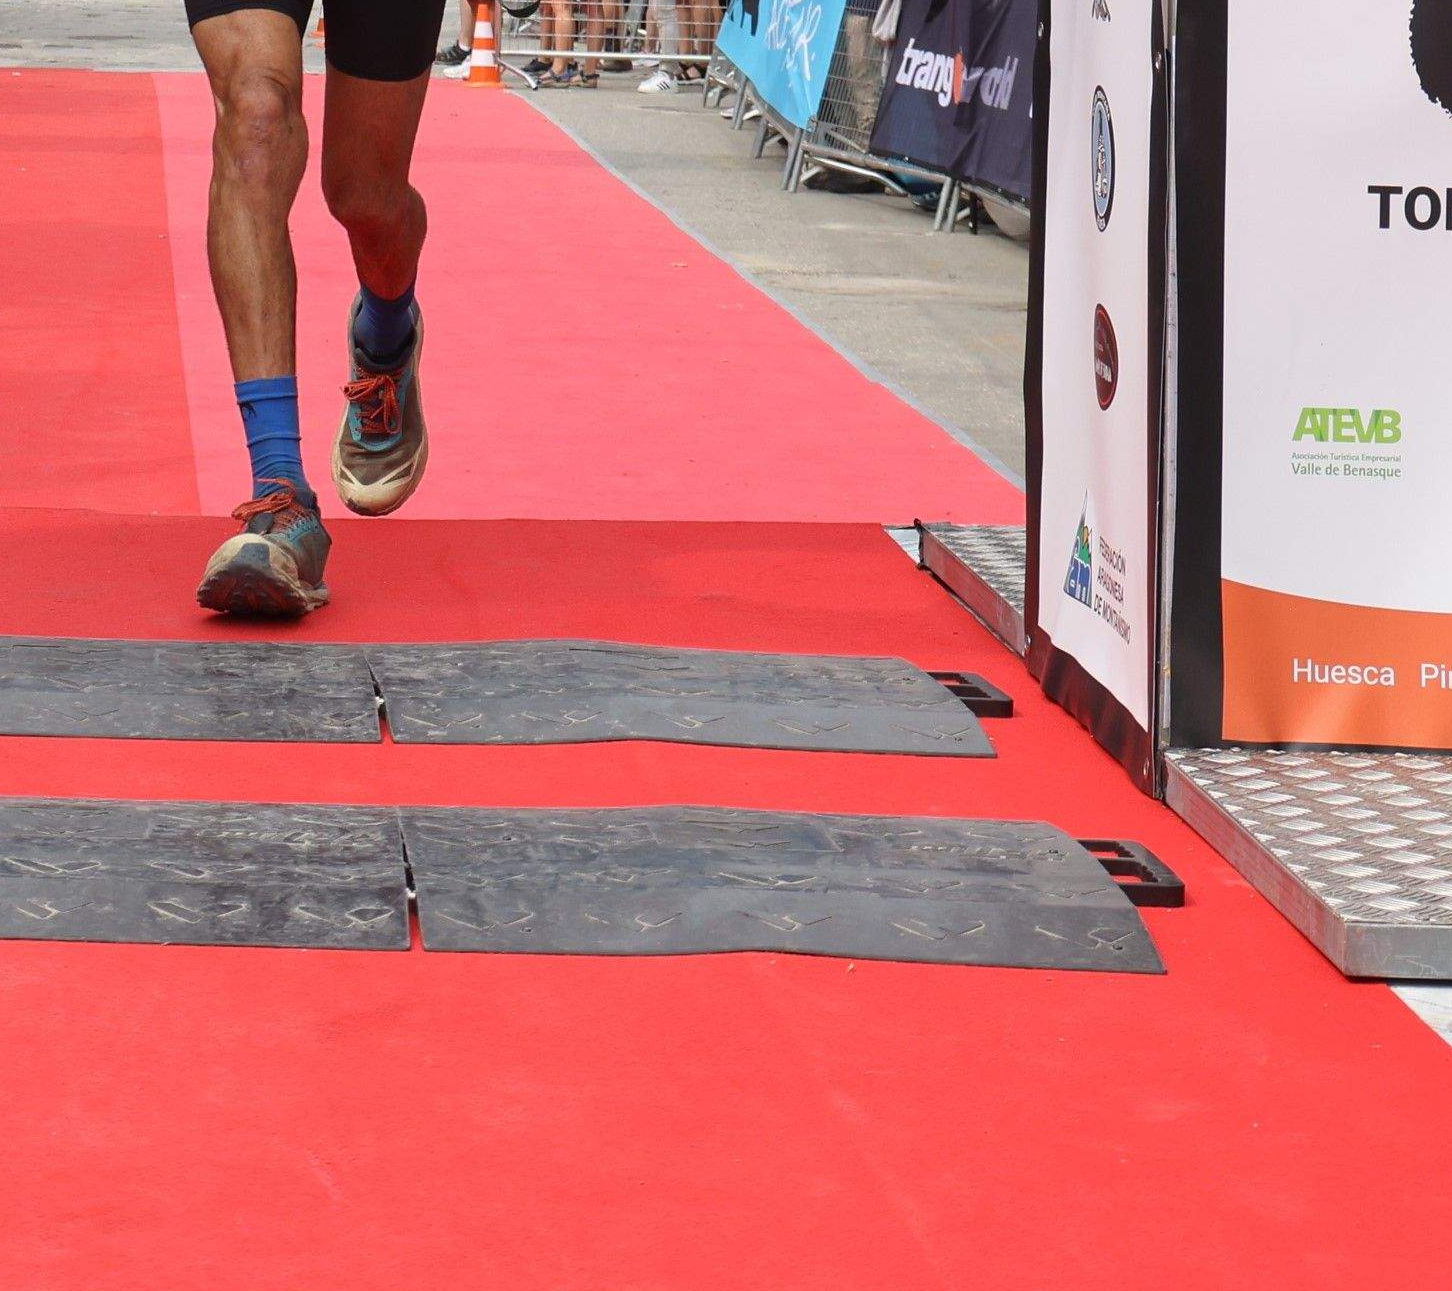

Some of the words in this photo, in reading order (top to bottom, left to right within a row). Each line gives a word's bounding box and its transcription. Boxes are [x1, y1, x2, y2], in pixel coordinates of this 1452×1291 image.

[1291, 407, 1403, 444] ATEVB
[1291, 462, 1321, 475] Valle
[1325, 463, 1339, 476] de
[1343, 464, 1402, 480] Benasque
[1292, 659, 1396, 687] Huesca
